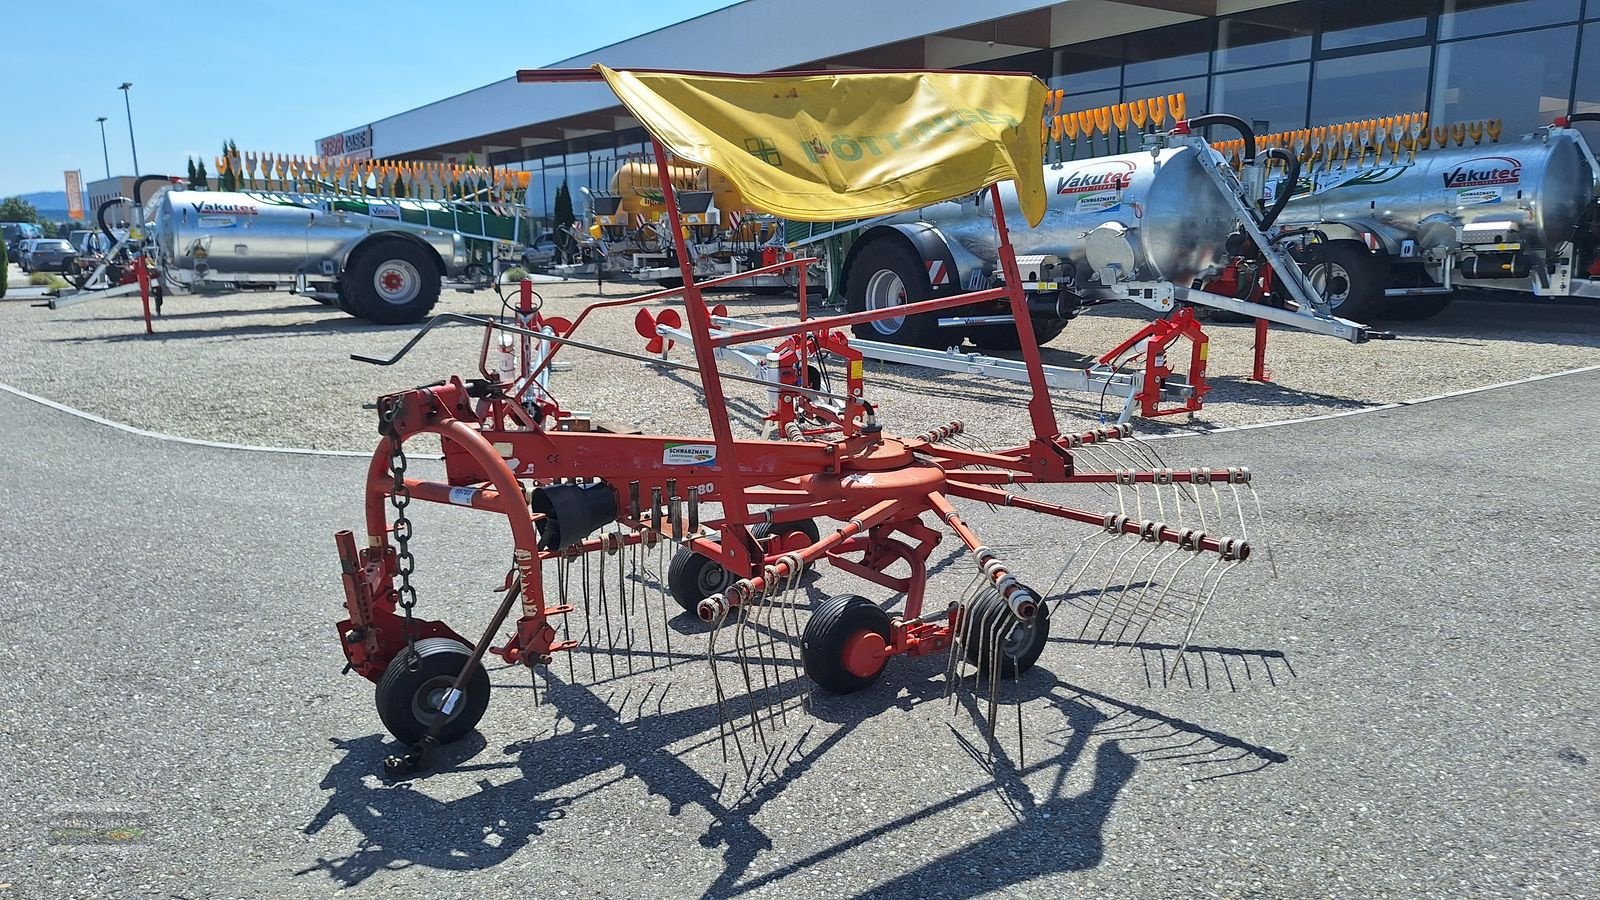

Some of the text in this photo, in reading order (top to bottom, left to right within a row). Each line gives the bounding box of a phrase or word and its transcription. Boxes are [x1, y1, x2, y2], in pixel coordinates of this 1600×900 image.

[1057, 171, 1135, 194] Vakutec
[1441, 167, 1522, 188] Vakutec
[191, 201, 258, 213] Vakutec
